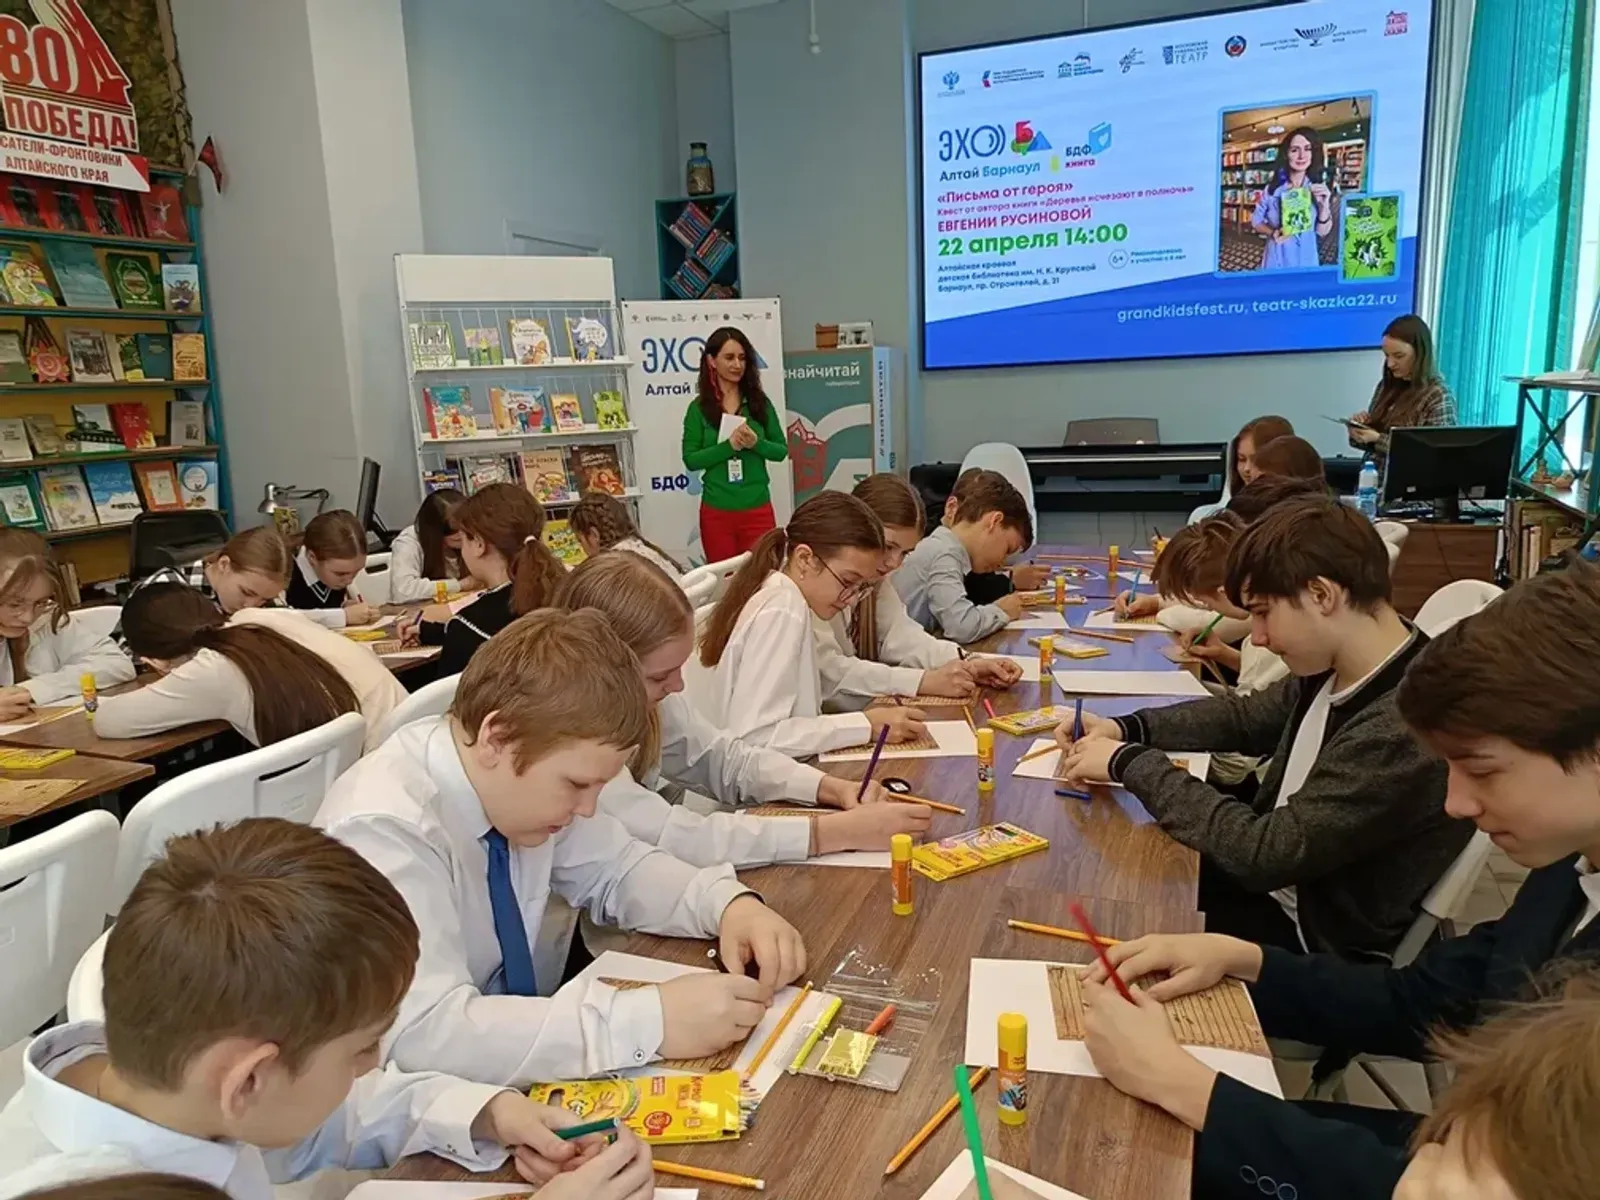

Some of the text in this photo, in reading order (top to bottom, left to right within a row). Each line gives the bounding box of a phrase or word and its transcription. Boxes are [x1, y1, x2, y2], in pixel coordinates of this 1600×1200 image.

[0, 16, 72, 93] 80
[1175, 51, 1208, 64] ТЕАТР
[4, 95, 137, 150] ПОБЕДА!
[0, 135, 123, 166] САТЕЛИ-ФРОНТОВИКИ
[1065, 144, 1091, 157] БДФ
[5, 155, 110, 182] АЛТАЙСКОГО КРАЯ
[940, 162, 1041, 182] Алтай Барнаул
[1065, 157, 1096, 168] книга
[937, 183, 1074, 203] «Письма от героя»
[937, 208, 963, 216] Квест
[976, 204, 1010, 213] автора
[1012, 201, 1038, 209] книги
[1088, 191, 1136, 201] исчезают
[1137, 190, 1144, 198] в
[938, 205, 1092, 232] ЕВГЕНИИ РУСИНОВОЙ
[938, 223, 1128, 256] 22 апреля 14:00
[938, 260, 1016, 272] Алтайская краевая
[938, 274, 970, 283] детская
[971, 270, 1020, 280] библиотека
[1055, 263, 1096, 275] Крупской
[976, 282, 989, 291] пр.
[1052, 277, 1060, 285] 21
[1117, 293, 1397, 322] grandkidsfest.ru, teatr-skazka22.ru
[645, 382, 691, 395] Алтай
[651, 472, 690, 490] БДФ
